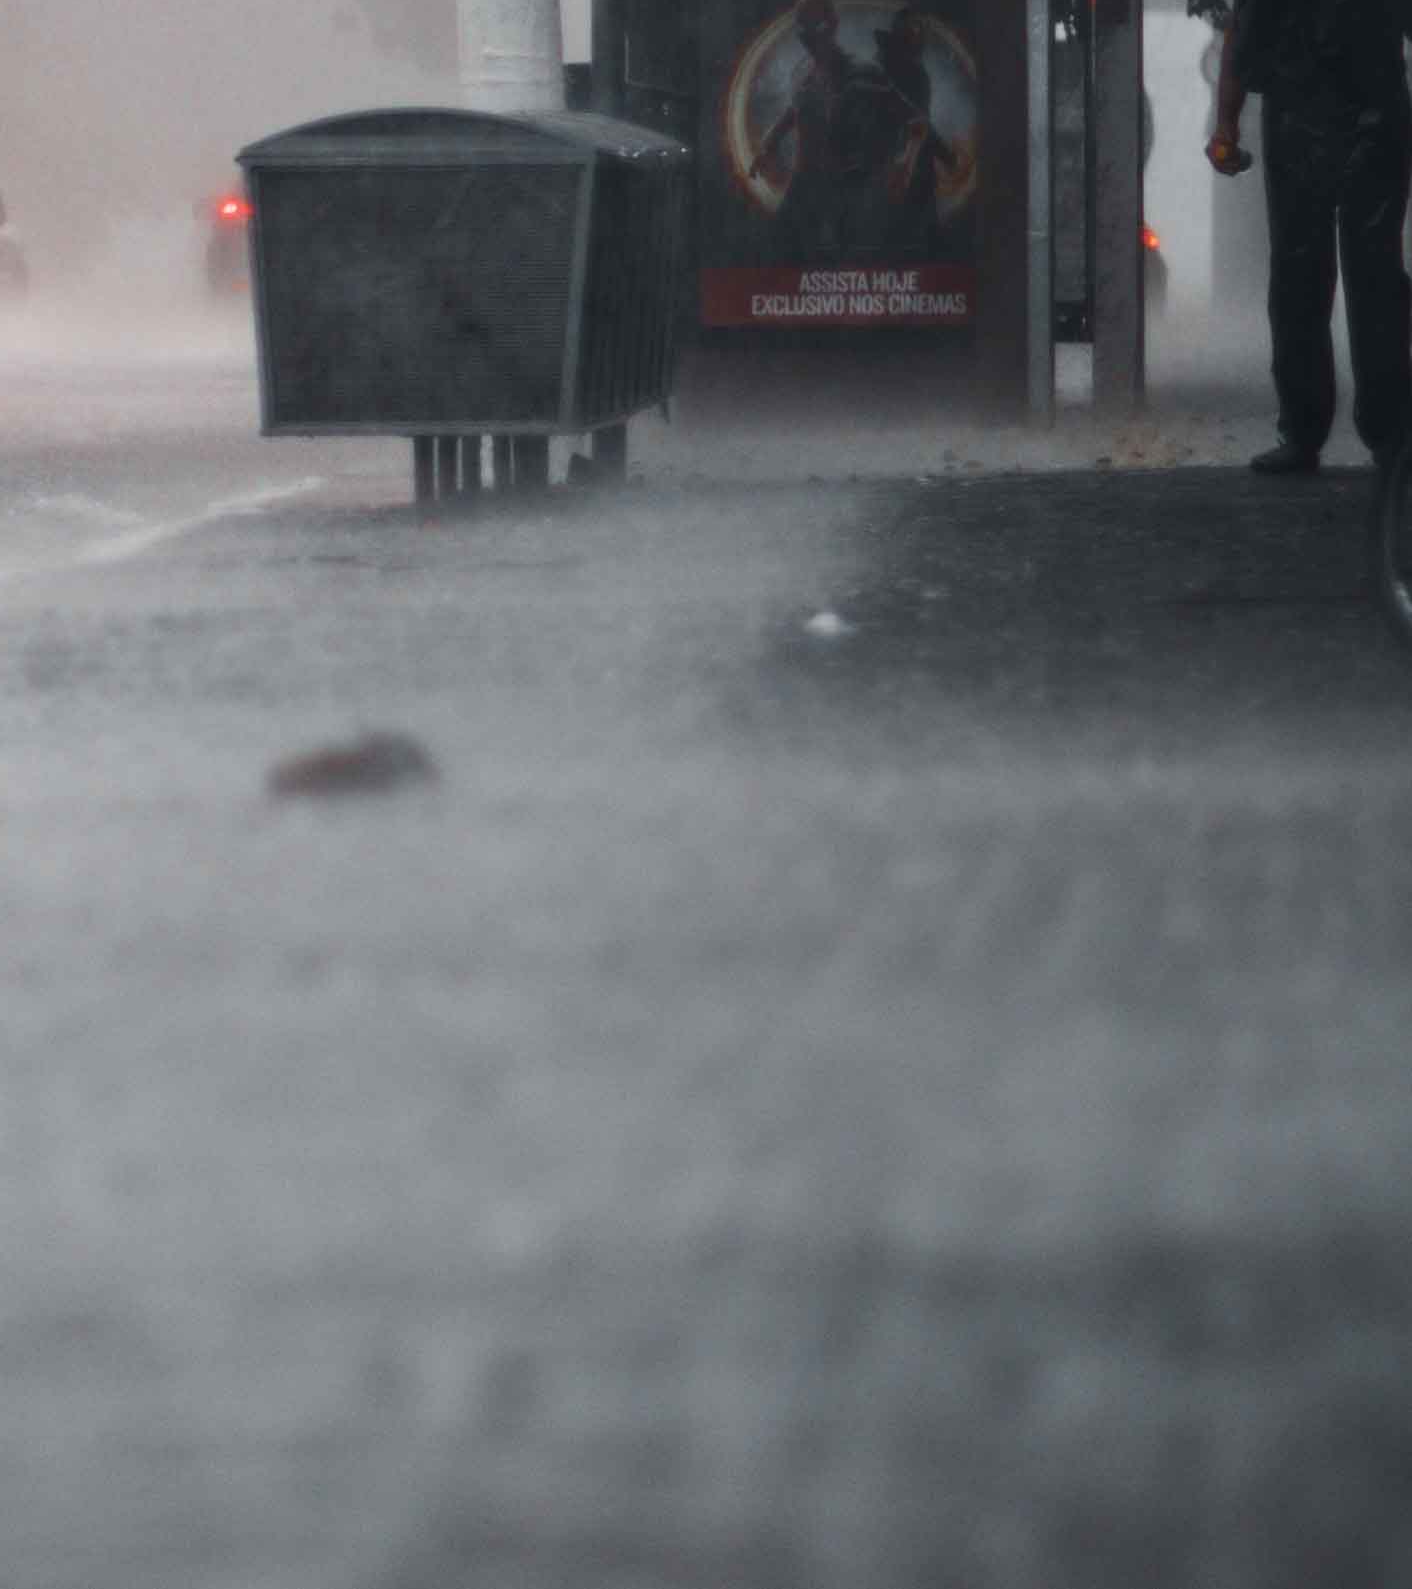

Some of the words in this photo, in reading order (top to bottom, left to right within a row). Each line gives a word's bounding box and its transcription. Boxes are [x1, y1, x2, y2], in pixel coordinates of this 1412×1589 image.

[799, 271, 867, 293] ASSISTA
[871, 271, 920, 292] HOJE
[751, 294, 845, 316] EXCLUSIVO
[848, 294, 884, 316] NOS
[888, 293, 967, 316] CINEMAS
